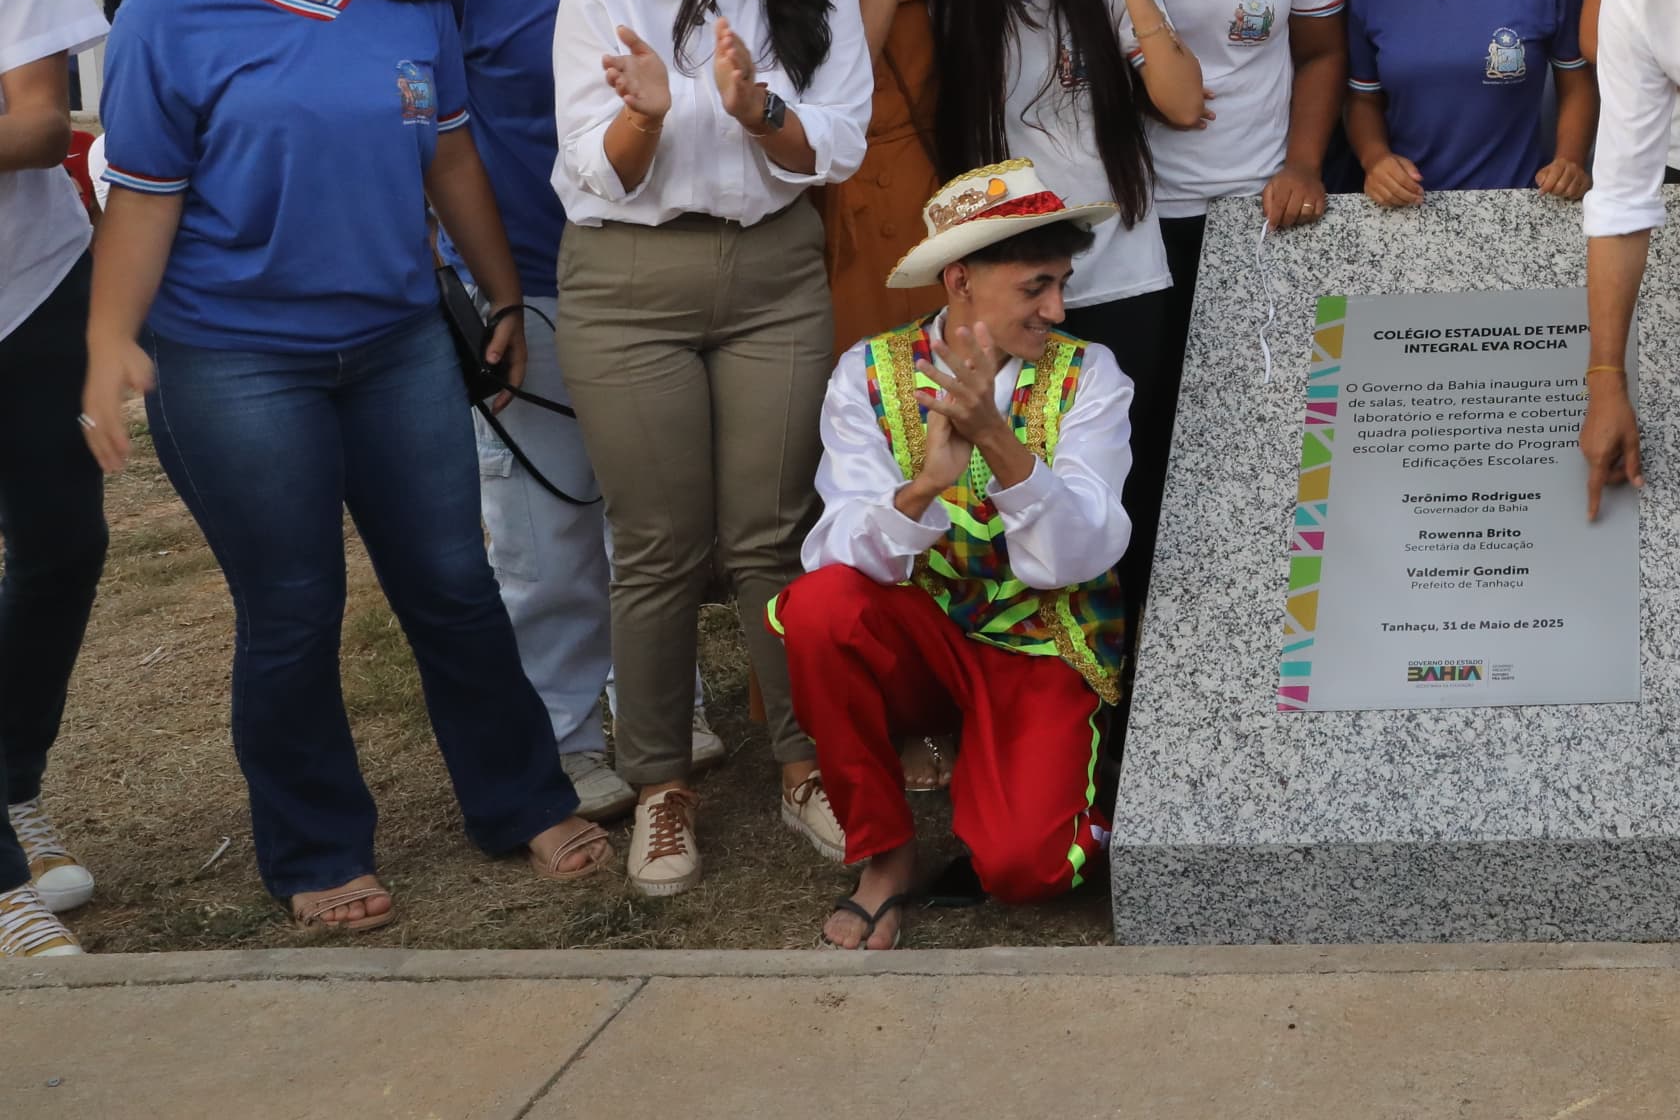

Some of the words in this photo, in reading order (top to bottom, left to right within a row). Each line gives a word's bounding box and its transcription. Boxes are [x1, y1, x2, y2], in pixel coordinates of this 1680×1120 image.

[1373, 328, 1441, 340] COLÉGIO
[1445, 327, 1520, 339] ESTADUAL
[1524, 326, 1543, 335] DE
[1404, 343, 1478, 354] INTEGRAL
[1481, 341, 1509, 351] EVA
[1513, 339, 1567, 350] ROCHA
[1346, 383, 1358, 393] O
[1362, 382, 1423, 392] Governo
[1426, 381, 1443, 390] da
[1448, 379, 1485, 390] Bahia
[1490, 379, 1551, 390] inaugura
[1556, 379, 1578, 387] um
[1348, 398, 1365, 407] de
[1370, 398, 1406, 407] salas,
[1411, 397, 1456, 406] teatro,
[1461, 393, 1541, 405] restaurante
[1545, 392, 1591, 403] estuda
[1353, 412, 1431, 423] laboratório
[1448, 410, 1504, 421] reforma
[1521, 408, 1590, 418] cobertura
[1358, 428, 1406, 440] quadra
[1411, 425, 1502, 439] poliesportiva
[1507, 424, 1544, 434] nesta
[1549, 422, 1584, 433] unid
[1352, 443, 1404, 453] escolar
[1408, 444, 1449, 452] como
[1454, 441, 1490, 453] parte
[1495, 440, 1513, 449] do
[1518, 439, 1580, 451] Program
[1402, 457, 1483, 469] Edificações
[1488, 455, 1558, 466] Escolares.
[1401, 493, 1468, 503] Jerônimo
[1472, 491, 1541, 502] Rodrigues
[1413, 505, 1479, 514] Governador
[1482, 504, 1495, 512] da
[1499, 504, 1528, 512] Bahia
[1419, 530, 1483, 540] Rowenna
[1487, 528, 1521, 538] Brito
[1463, 542, 1476, 550] da
[1480, 541, 1533, 551] Educação
[1407, 567, 1470, 577] Valdemir
[1474, 566, 1529, 576] Gondim
[1411, 580, 1455, 589] Prefeito
[1458, 580, 1472, 589] de
[1476, 579, 1523, 589] Tanhaçu
[1381, 622, 1438, 633] Tanhaçu,
[1443, 621, 1457, 630] 31
[1460, 621, 1476, 630] de
[1480, 620, 1510, 630] Maio
[1514, 620, 1529, 629] de
[1532, 619, 1564, 628] 2025
